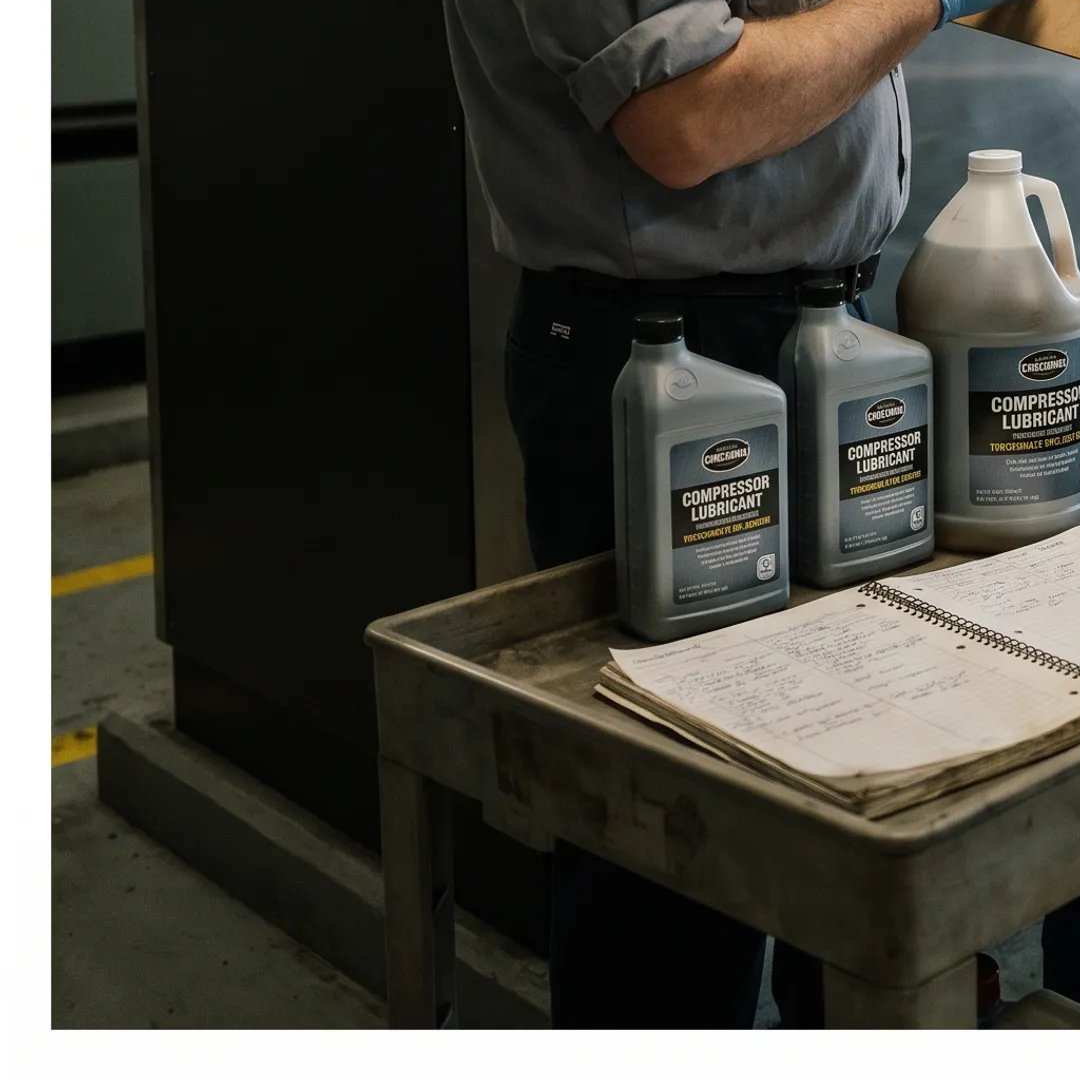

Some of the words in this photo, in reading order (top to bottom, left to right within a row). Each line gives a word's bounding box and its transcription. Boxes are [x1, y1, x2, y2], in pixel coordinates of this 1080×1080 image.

[1002, 403, 1080, 431] LUBRICANT
[847, 430, 922, 461] COMPRESSOR
[856, 447, 916, 475] LUBRICANT
[682, 474, 770, 508] COMPRESSOR
[691, 492, 763, 522] LUBRICANT
